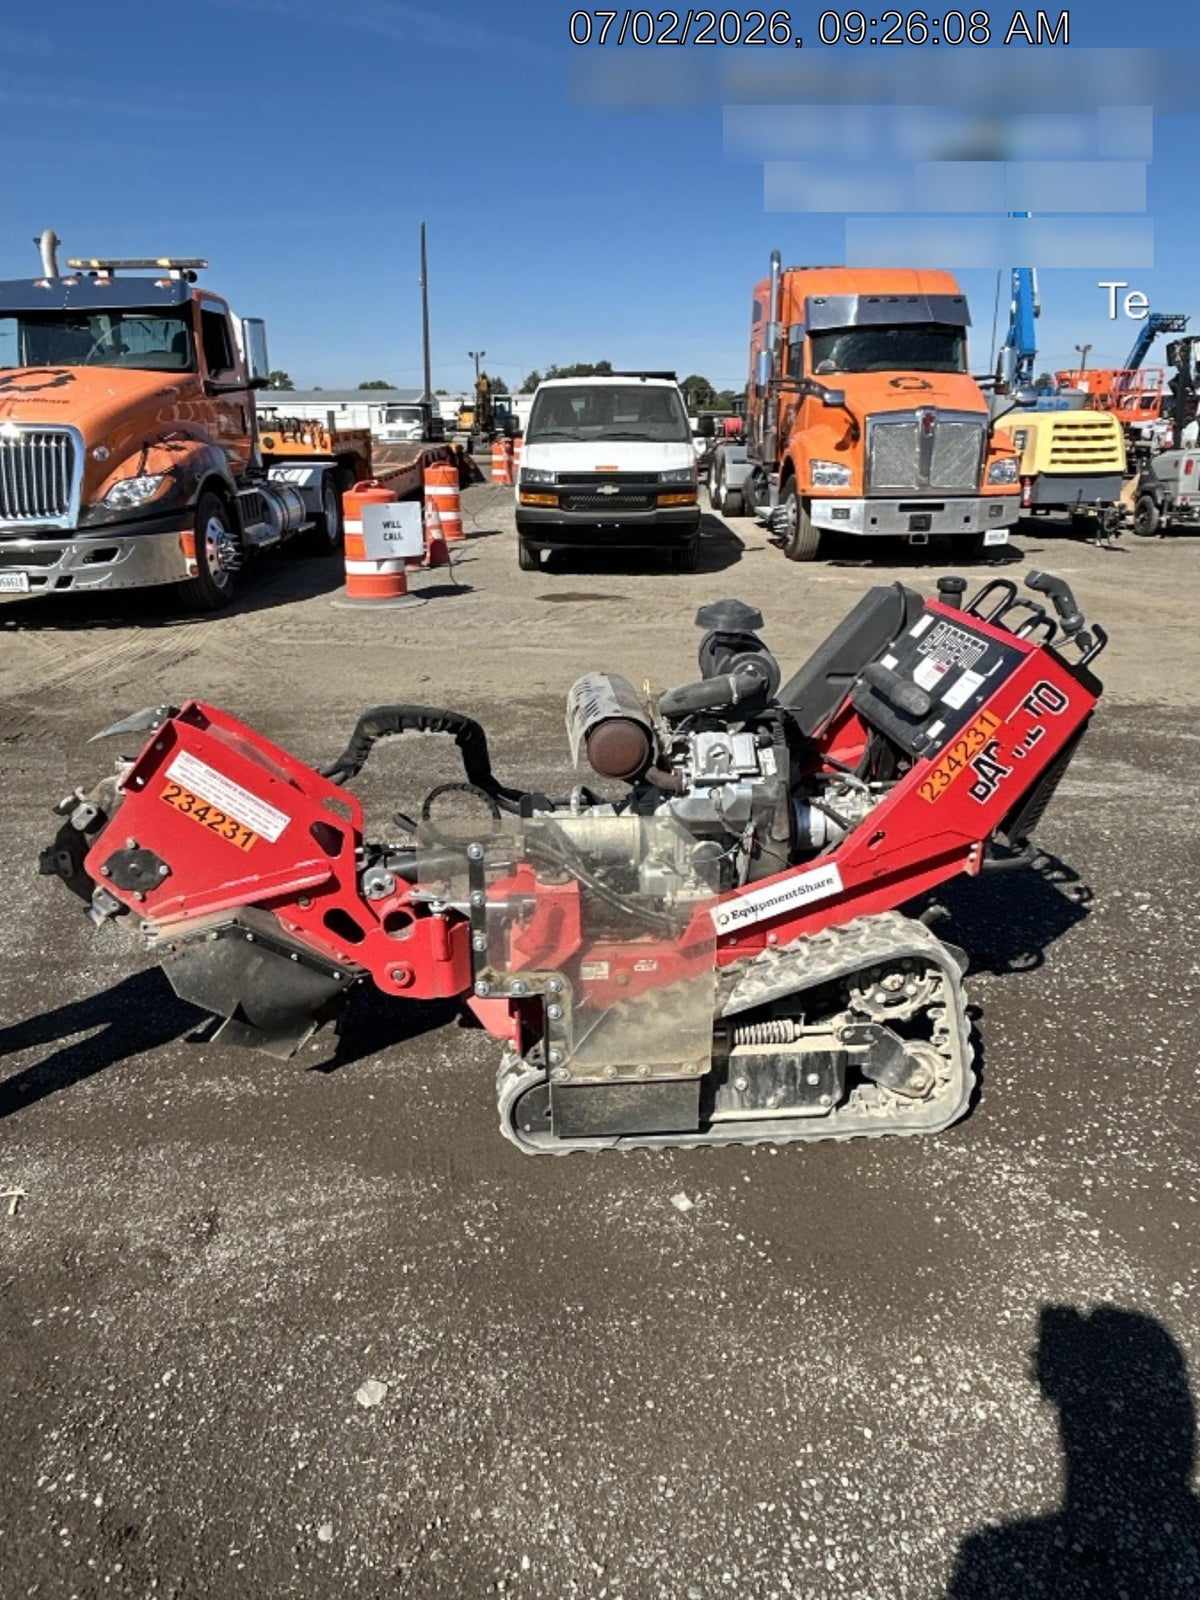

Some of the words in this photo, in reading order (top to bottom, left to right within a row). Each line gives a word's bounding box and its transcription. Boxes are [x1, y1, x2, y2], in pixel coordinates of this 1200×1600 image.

[382, 520, 402, 529] WILL
[383, 532, 404, 541] CALL
[920, 715, 997, 801] 234231
[162, 785, 254, 848] 234231
[730, 877, 835, 921] EquipmentShare
